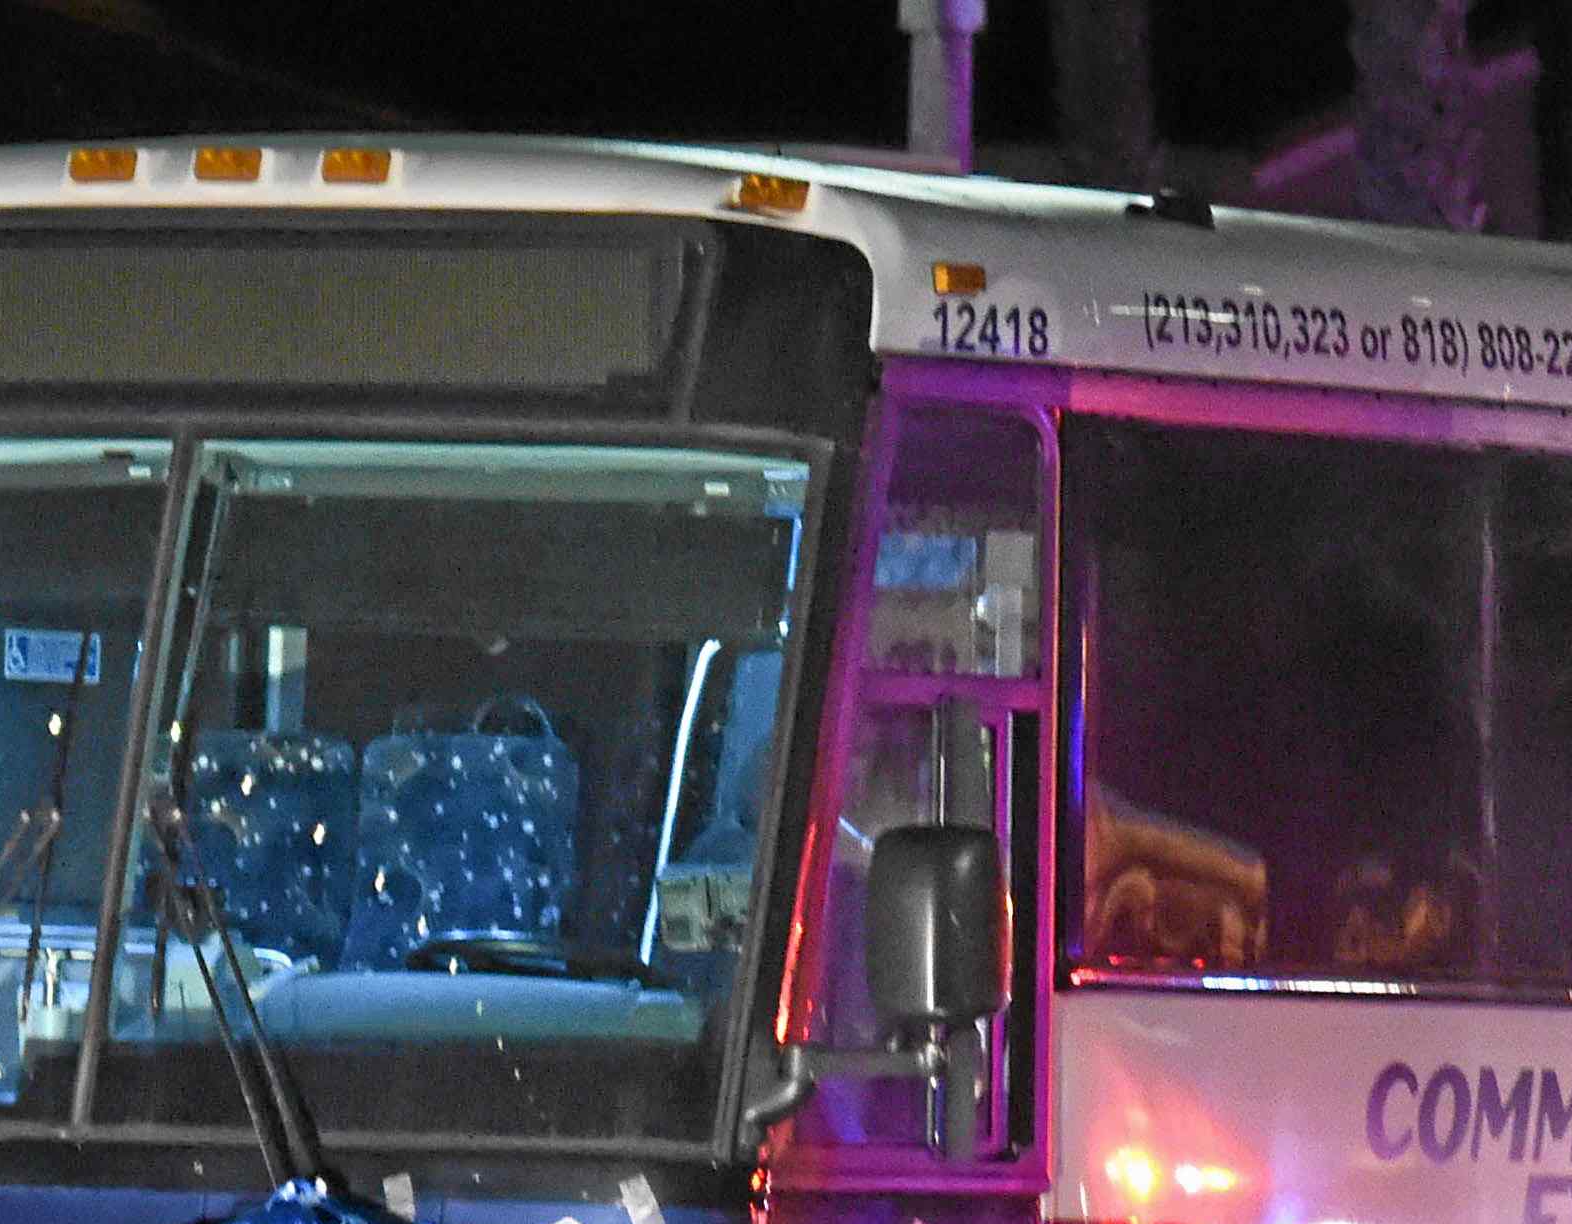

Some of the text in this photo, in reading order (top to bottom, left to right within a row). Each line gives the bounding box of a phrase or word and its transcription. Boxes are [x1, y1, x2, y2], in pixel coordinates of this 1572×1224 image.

[933, 301, 1049, 356] 12418
[1360, 318, 1391, 357] or
[1402, 315, 1469, 372] 818)
